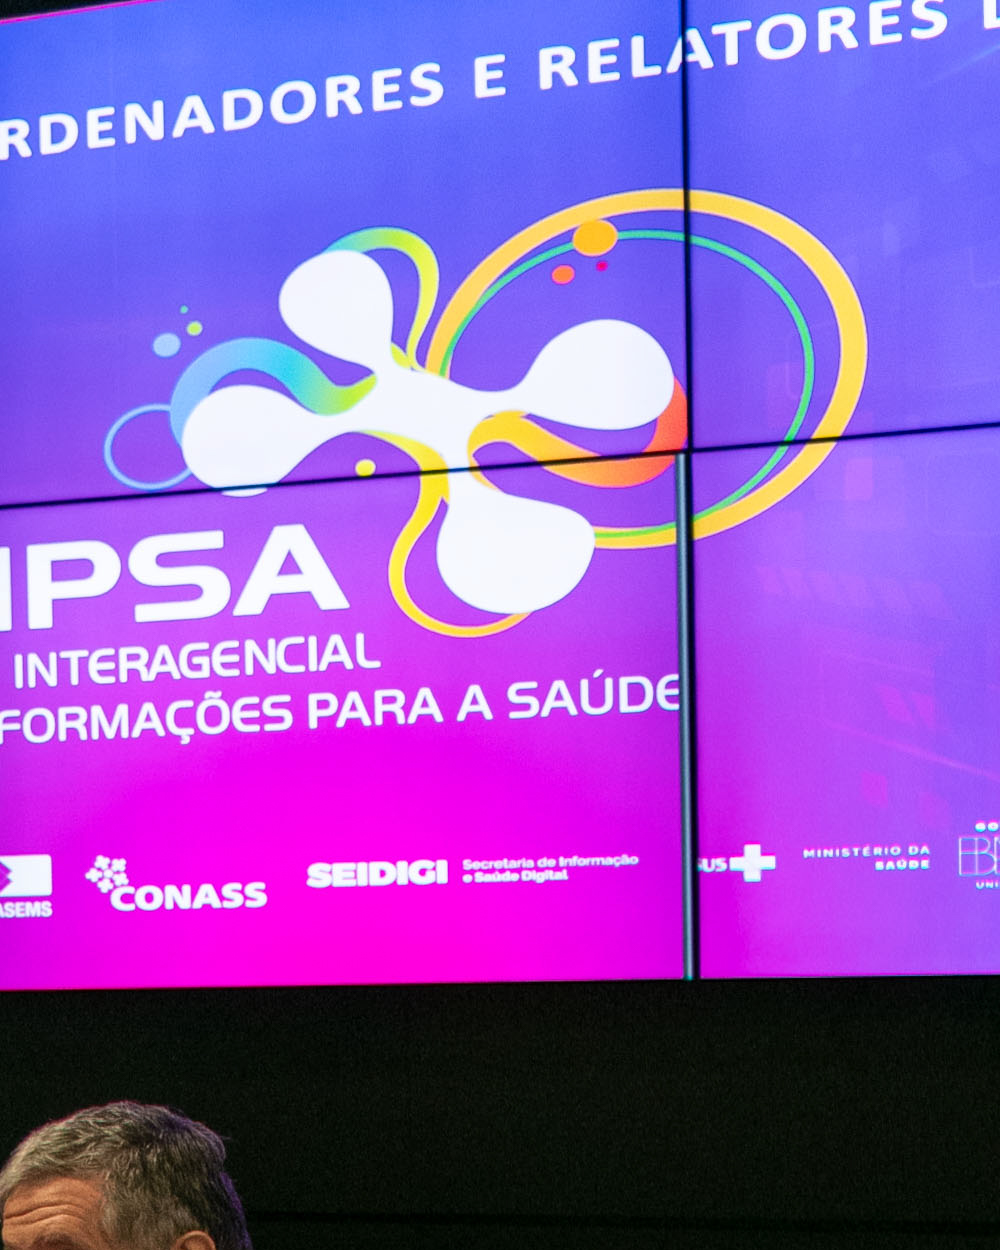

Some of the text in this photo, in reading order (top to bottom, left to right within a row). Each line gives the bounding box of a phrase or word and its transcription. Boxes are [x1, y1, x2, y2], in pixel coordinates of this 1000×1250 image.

[474, 54, 507, 99] E
[538, 0, 948, 90] RELATORES
[13, 632, 382, 689] INTERAGENCIAL
[308, 687, 444, 730] PARA
[456, 684, 494, 723] A
[507, 668, 681, 719] SAÚDE
[462, 853, 640, 871] Secretaria de Informação
[802, 844, 931, 859] MINISTÉRIO DA
[874, 859, 931, 871] SAÚDE
[306, 859, 449, 888] SEIDIGI
[110, 881, 268, 912] CONASS
